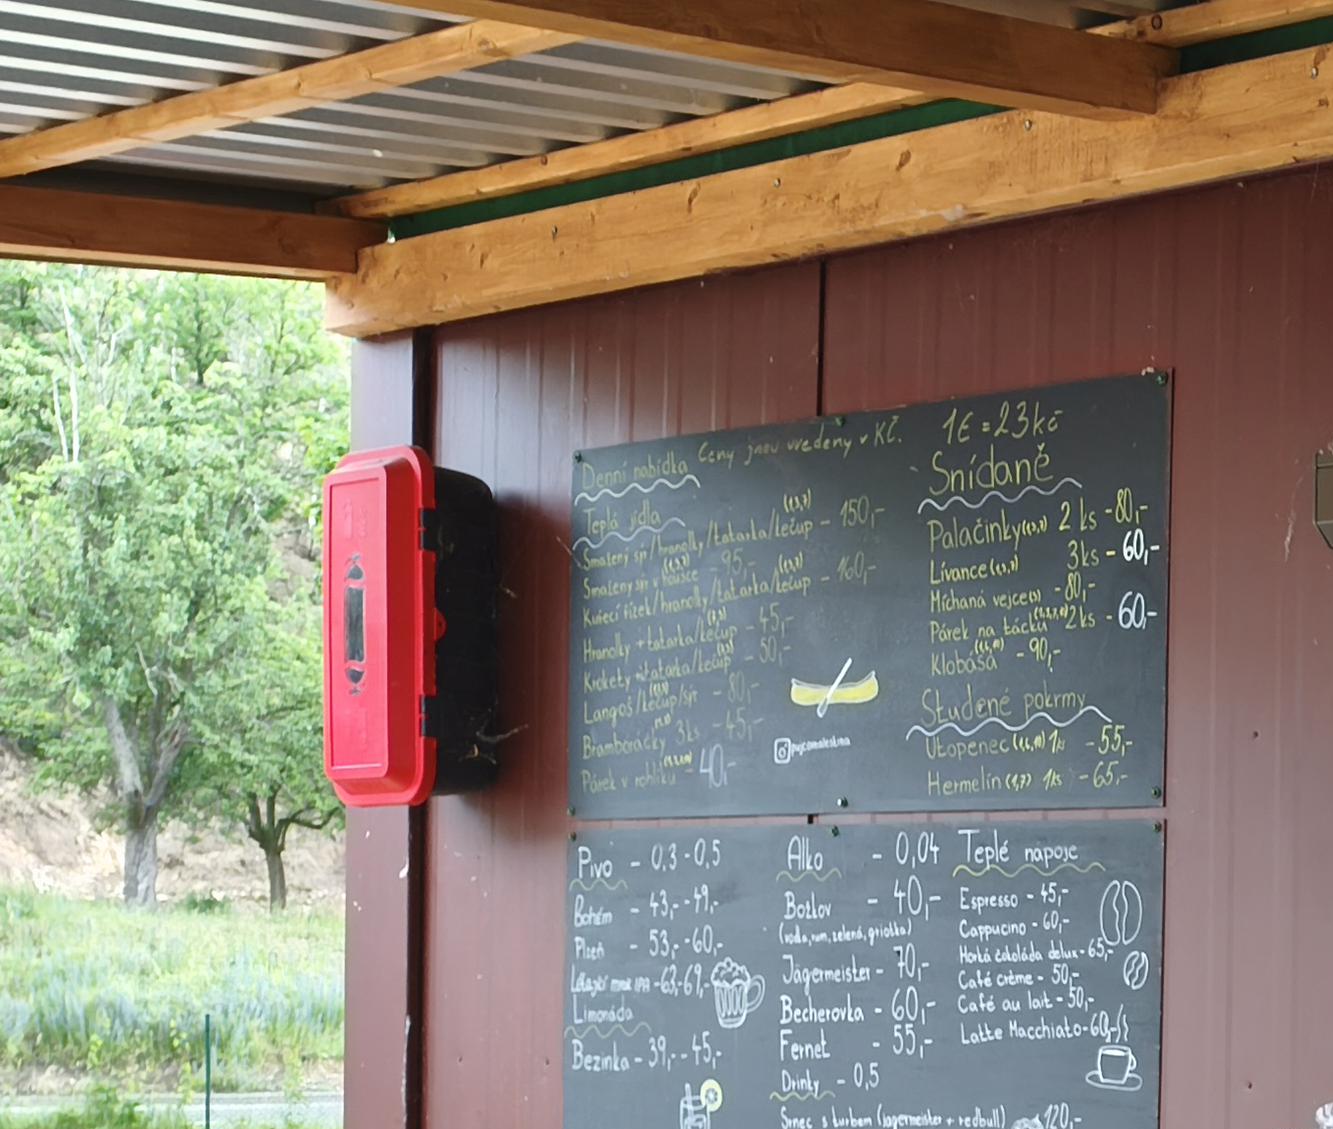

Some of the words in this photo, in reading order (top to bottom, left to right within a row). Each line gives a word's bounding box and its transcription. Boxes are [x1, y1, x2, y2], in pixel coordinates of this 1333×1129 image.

[582, 461, 627, 491] Denní
[929, 442, 1054, 496] Snídaně
[583, 506, 619, 537] Teplá
[930, 557, 988, 586] Lívance
[930, 589, 987, 614] Míchaná
[930, 618, 970, 644] Párek
[978, 625, 996, 638] na
[930, 650, 998, 677] Klobása
[921, 684, 1014, 728] Studené
[1024, 680, 1087, 721] pokrmy
[925, 735, 1011, 761] Utopenec
[928, 765, 1002, 797] Hermelín
[578, 846, 613, 879] Pivo
[787, 835, 824, 871] Alko
[896, 832, 940, 869] 0,04
[957, 829, 1011, 870] Teplé
[574, 894, 613, 928] Bohém
[784, 890, 832, 920] Božkov
[894, 875, 942, 921] 40,-
[960, 886, 1019, 915] Espresso
[959, 919, 1027, 942] Cappucino
[893, 942, 930, 982] 70,-
[959, 943, 992, 964] Horká
[995, 939, 1044, 963] čokoláda
[958, 968, 993, 990] Café
[573, 994, 634, 1025] Limonáda
[780, 992, 865, 1025] Becherovka
[892, 985, 937, 1025] 60,-
[958, 992, 997, 1014] Café
[1002, 1000, 1022, 1013] au
[1028, 990, 1054, 1011] lait
[780, 1028, 831, 1061] Fernet
[893, 1023, 934, 1060] 55,-
[960, 1016, 1004, 1045] Latte
[572, 1038, 630, 1072] Bezinka
[782, 1069, 820, 1098] Drinky
[854, 1062, 880, 1091] 0,5
[822, 1116, 829, 1129] s
